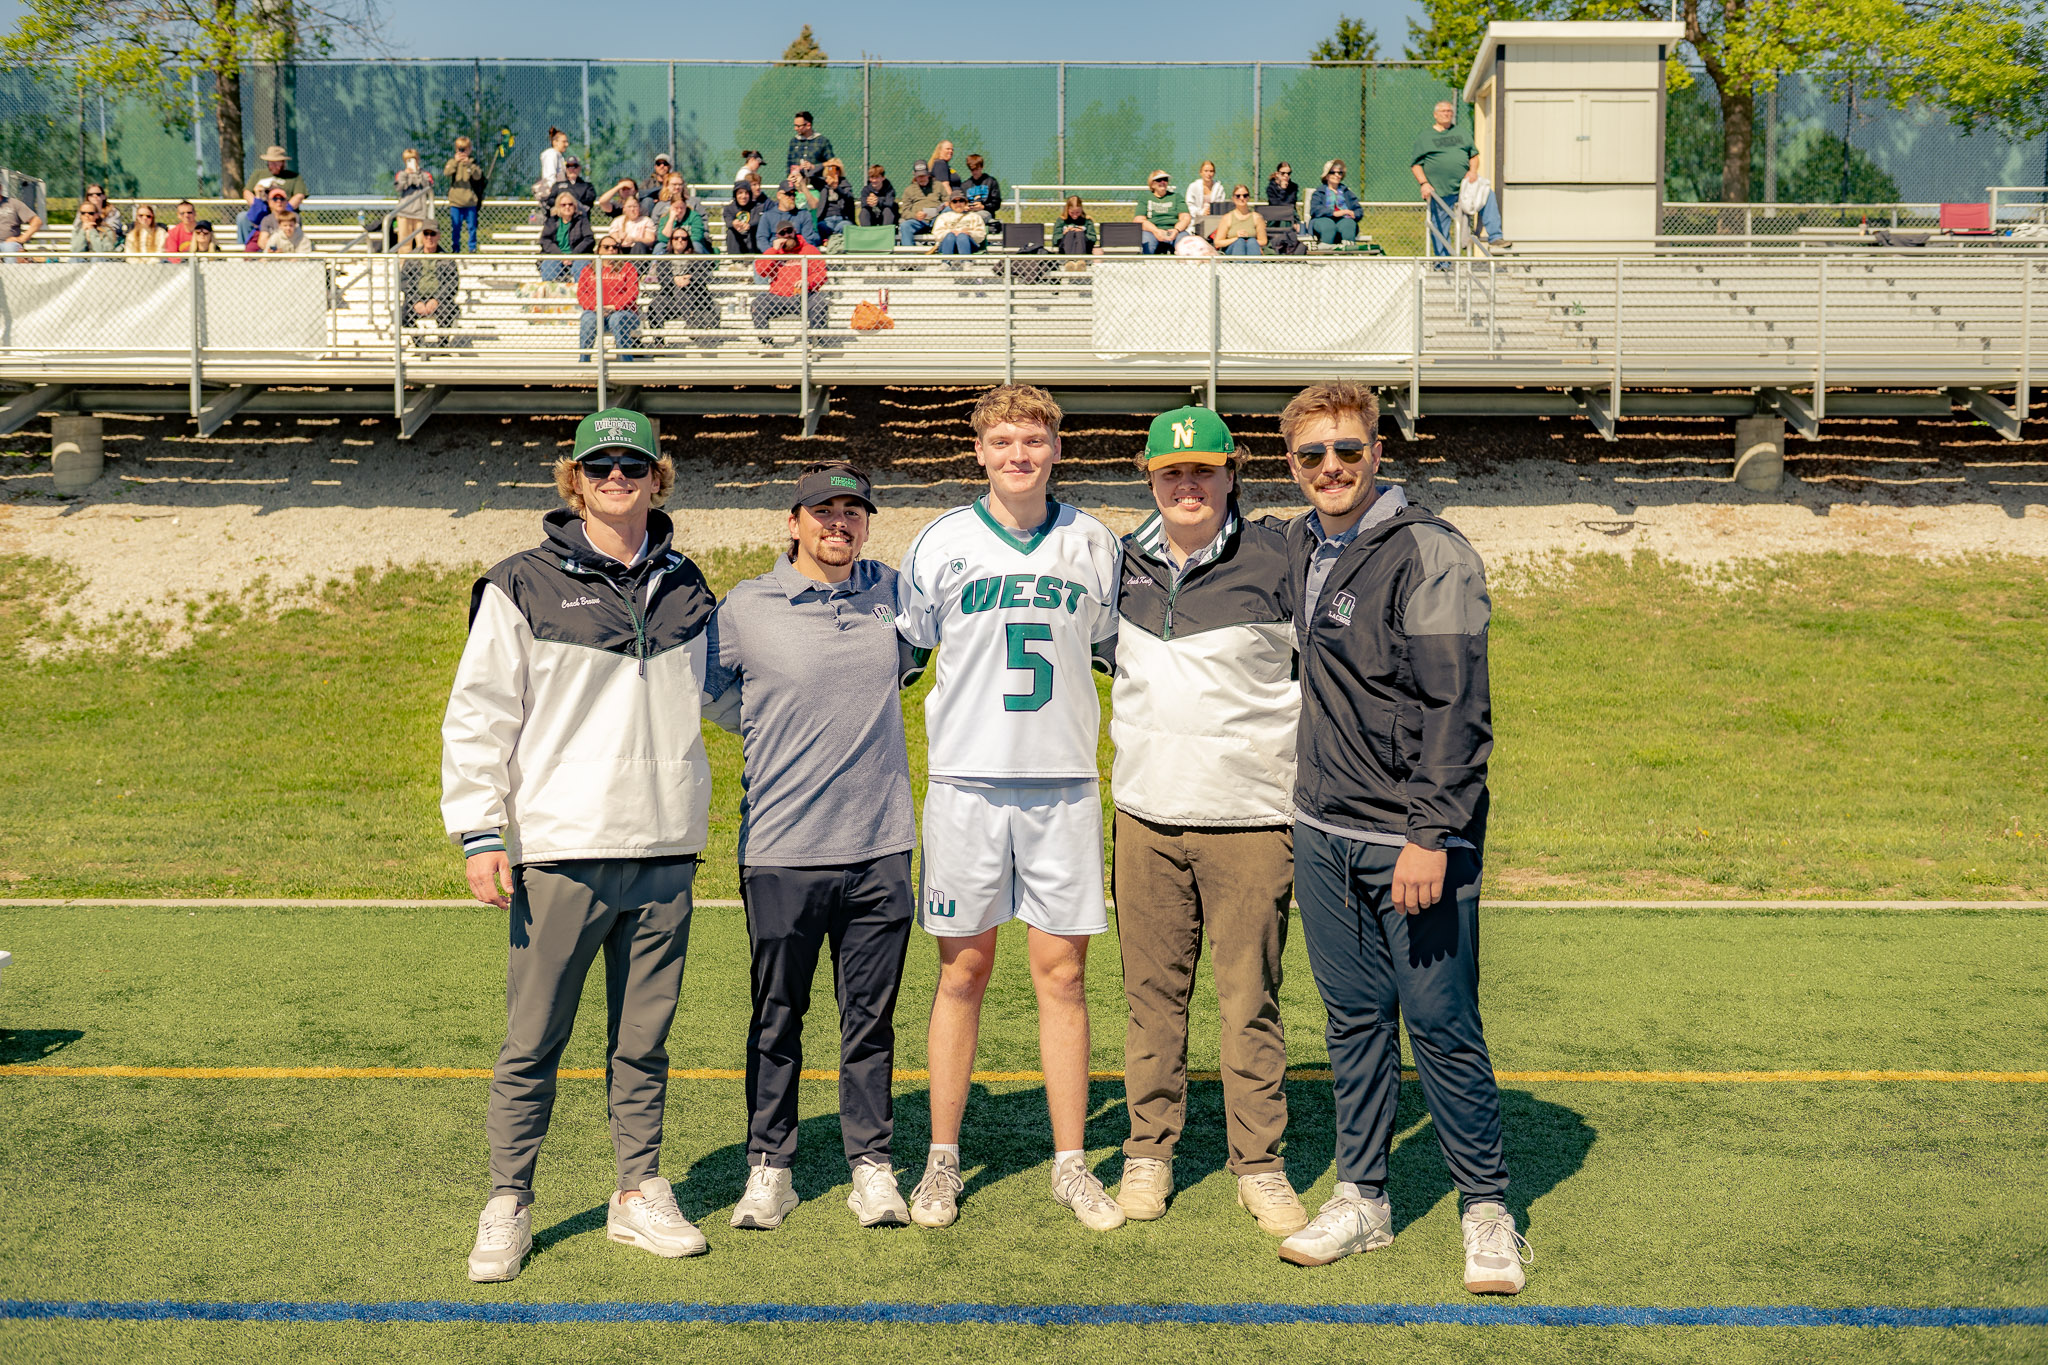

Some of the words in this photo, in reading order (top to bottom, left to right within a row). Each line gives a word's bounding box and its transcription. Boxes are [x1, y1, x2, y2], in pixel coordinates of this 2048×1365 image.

[1171, 422, 1197, 449] N
[561, 597, 580, 609] Coach
[961, 573, 1089, 615] WEST
[1002, 622, 1055, 713] 5
